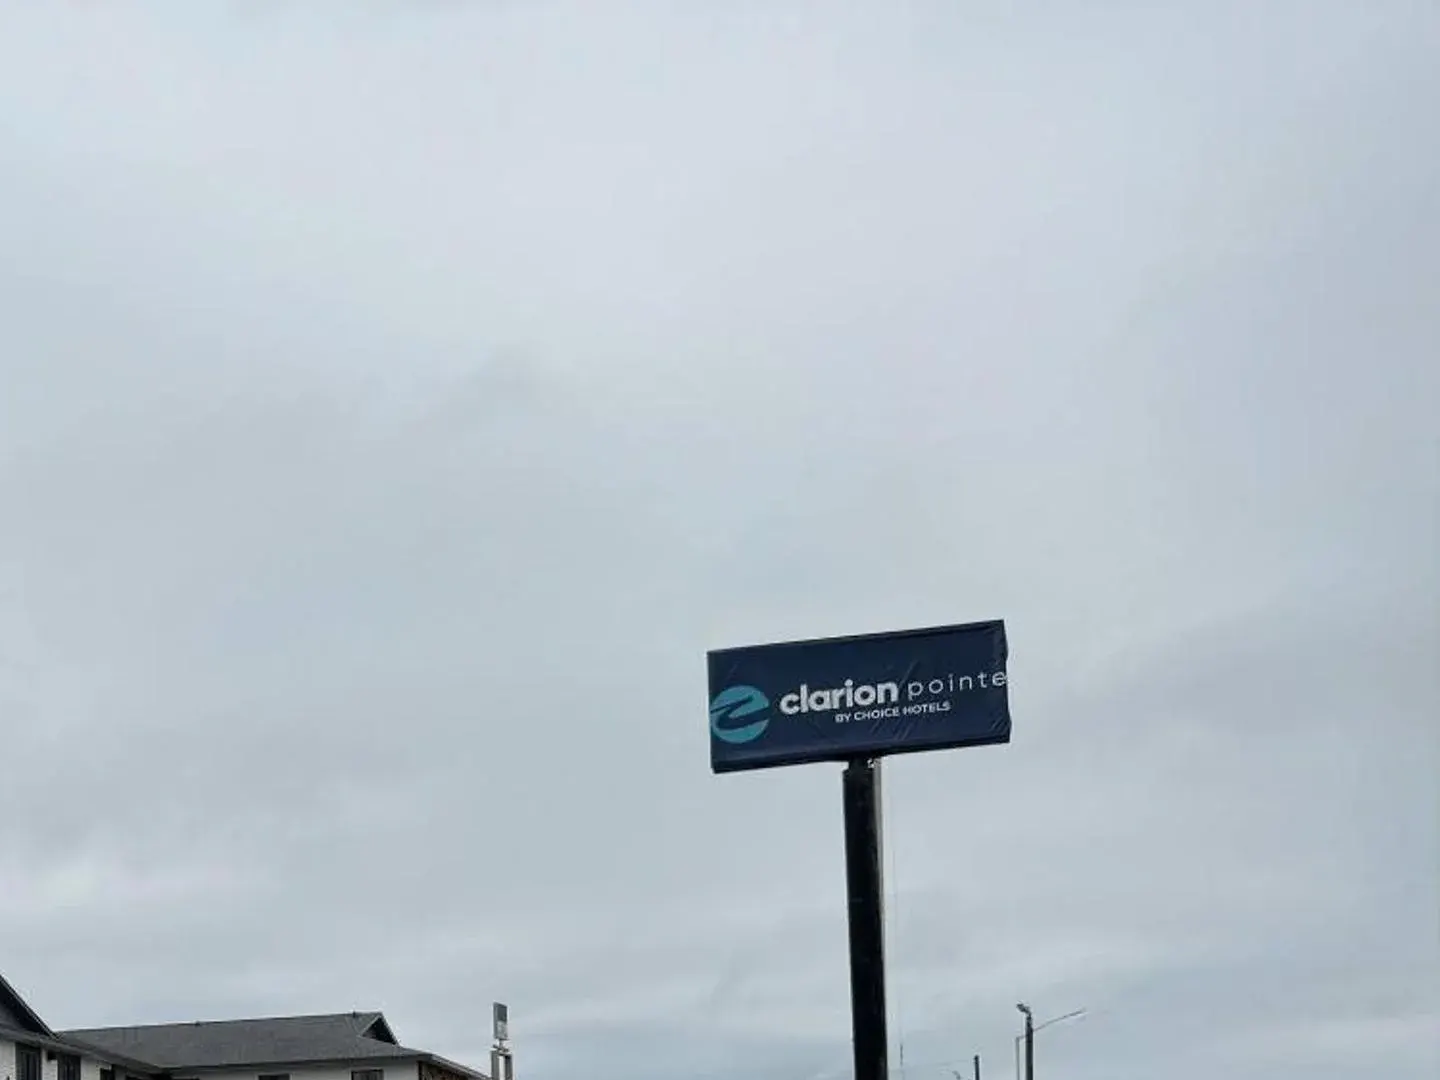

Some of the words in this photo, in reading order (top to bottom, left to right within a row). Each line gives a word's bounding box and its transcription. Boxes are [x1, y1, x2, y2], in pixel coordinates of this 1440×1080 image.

[779, 678, 899, 715] clarion
[907, 671, 1007, 701] pointe
[835, 713, 851, 723] BY
[854, 706, 899, 721] CHOICE
[902, 700, 951, 716] HOTELS
